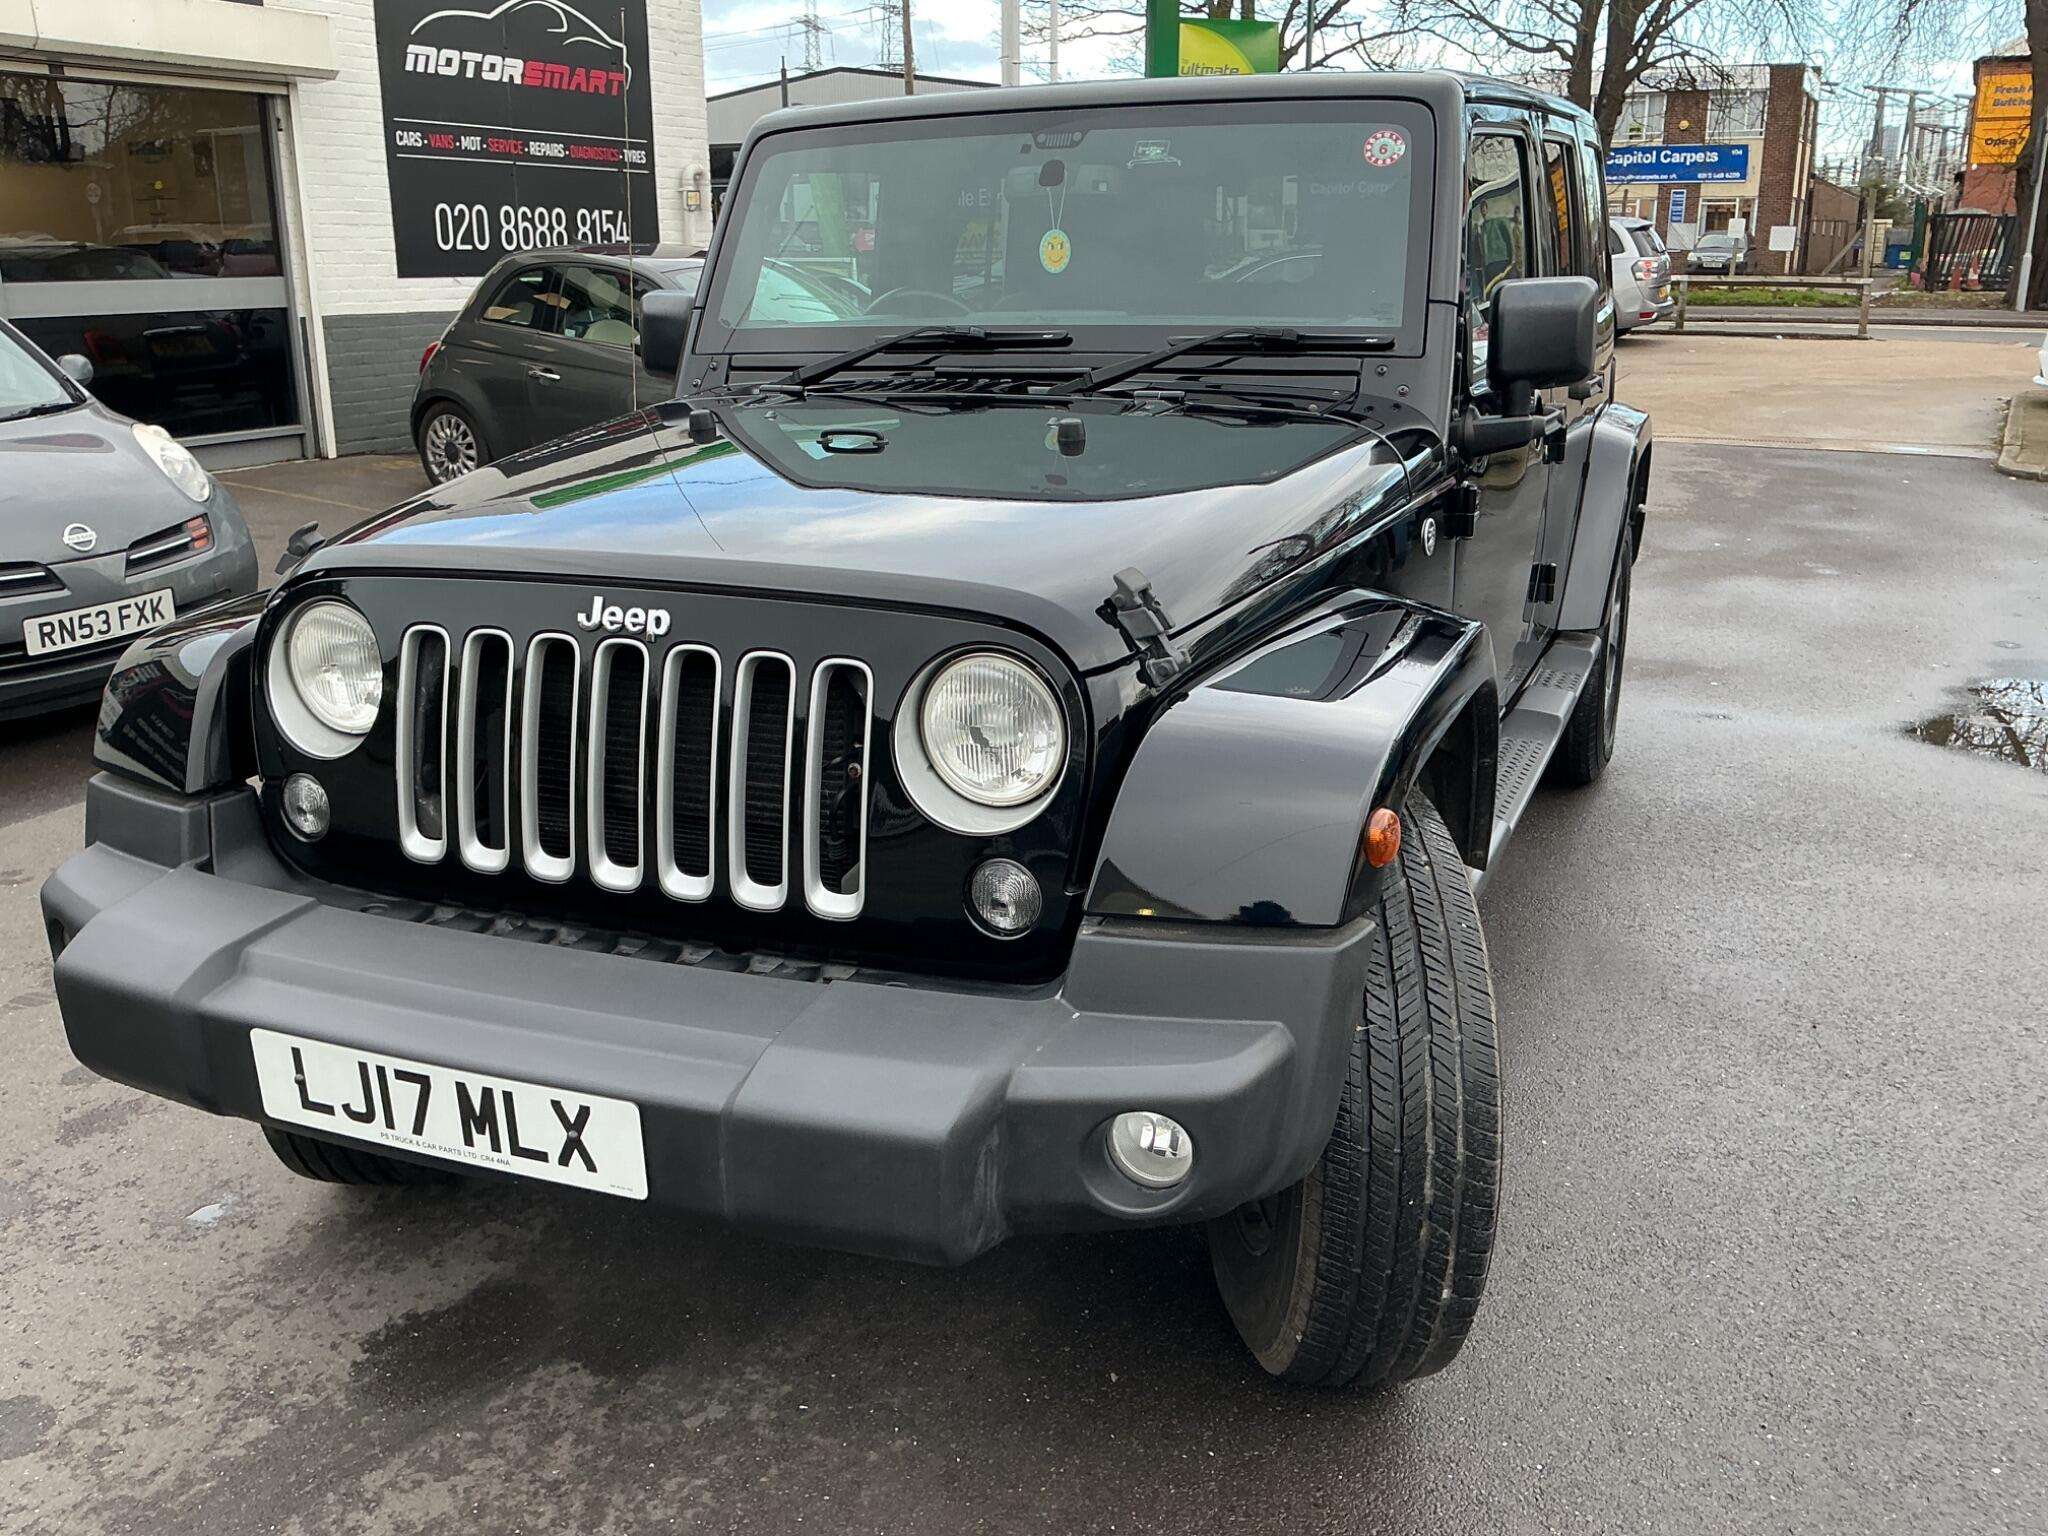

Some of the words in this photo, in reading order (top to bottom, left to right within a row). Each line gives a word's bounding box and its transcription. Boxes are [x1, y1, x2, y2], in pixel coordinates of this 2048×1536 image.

[404, 44, 624, 96] MOTORSMART
[1181, 62, 1240, 75] ultimate
[1995, 85, 2025, 94] Fresh
[395, 130, 422, 147] CARS
[428, 133, 454, 149] VANS
[460, 135, 482, 151] MOT
[488, 137, 524, 154] SERVICE
[529, 141, 565, 157] REPAIRS
[569, 144, 619, 162] DIAGNOSTICS
[622, 148, 647, 164] TYRES
[1606, 150, 1656, 166] Capitol
[1660, 150, 1719, 165] Carpets
[1984, 137, 2017, 147] Open
[434, 202, 491, 251] 020
[499, 204, 569, 251] 8688
[576, 208, 631, 244] 8154
[38, 609, 111, 649] RN53
[118, 595, 166, 631] FXK
[577, 595, 671, 642] Jeep
[291, 1046, 432, 1137] LJ17
[455, 1080, 598, 1174] MLX
[391, 1134, 414, 1145] TRUCK
[422, 1141, 437, 1150] CAR
[438, 1145, 462, 1156] PARTS
